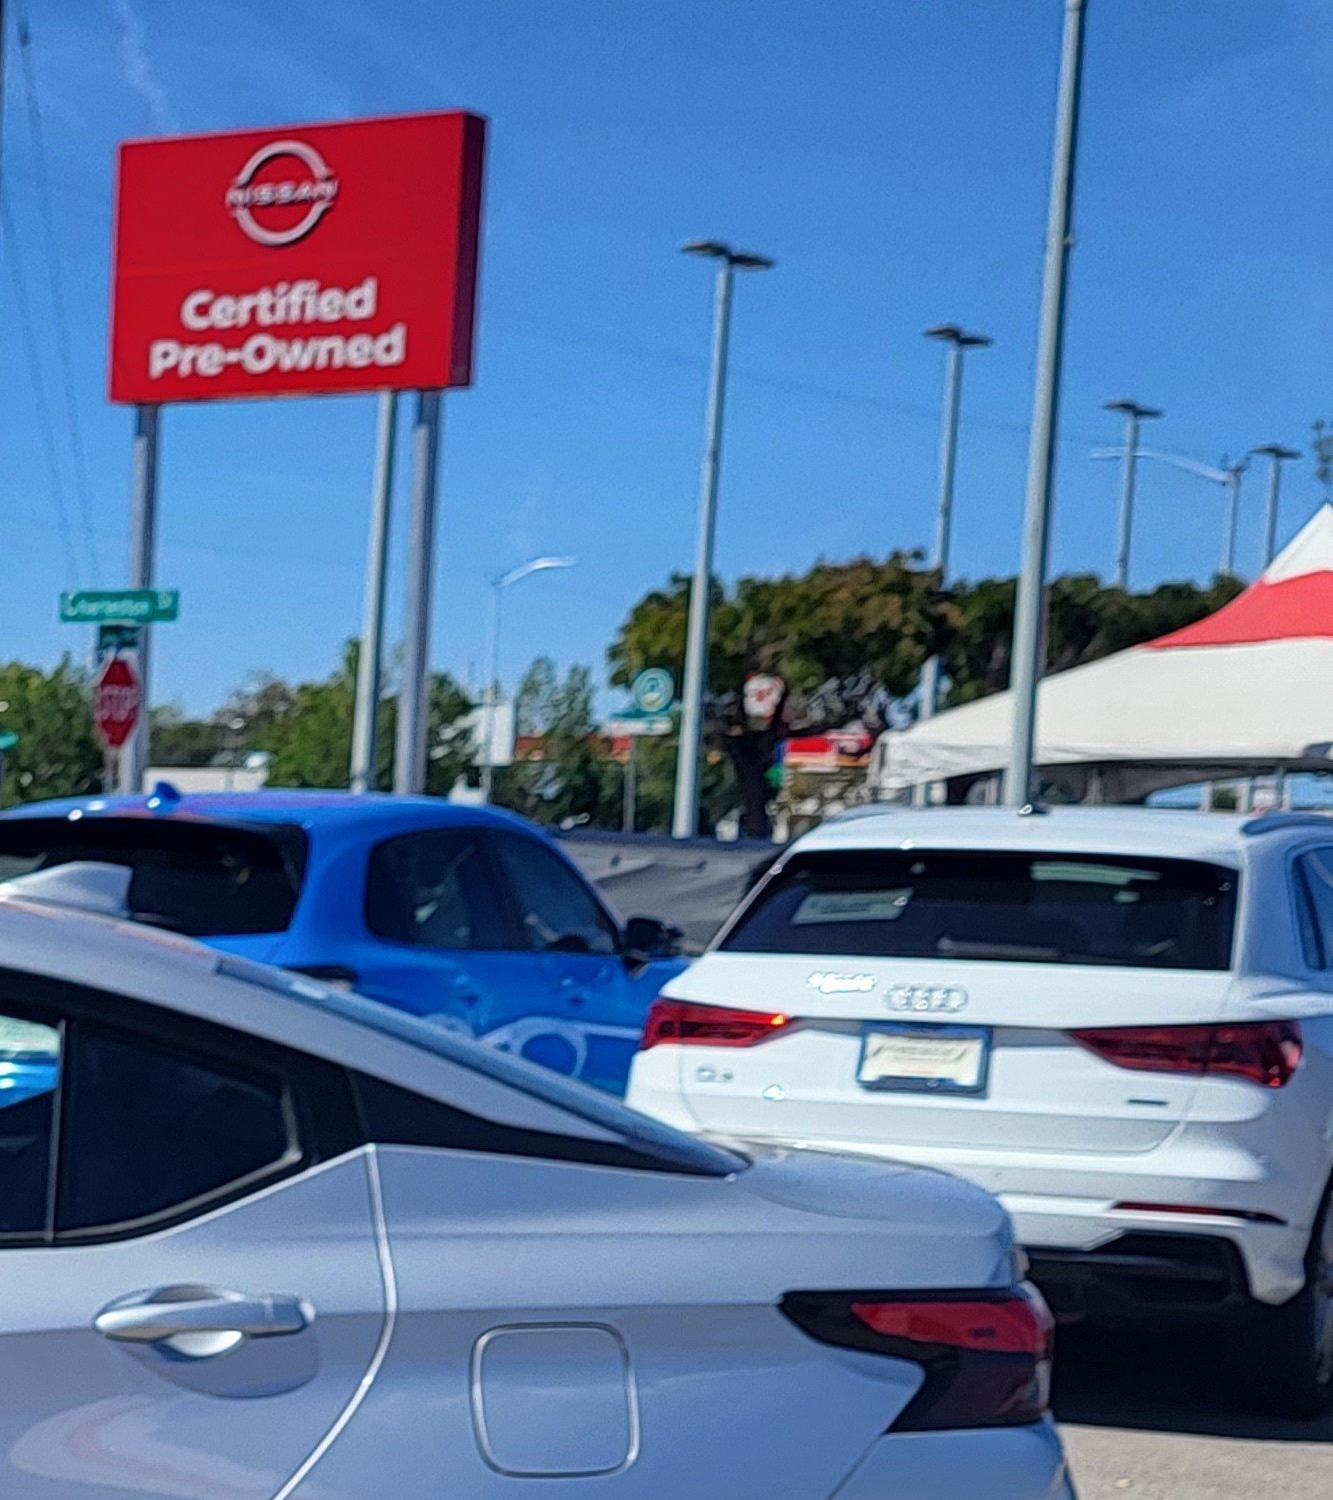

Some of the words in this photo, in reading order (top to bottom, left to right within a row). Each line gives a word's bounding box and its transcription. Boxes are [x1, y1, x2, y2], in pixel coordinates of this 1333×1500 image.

[225, 177, 338, 209] NISSAN
[181, 276, 378, 331] Certified
[148, 323, 406, 380] Pre-Owned
